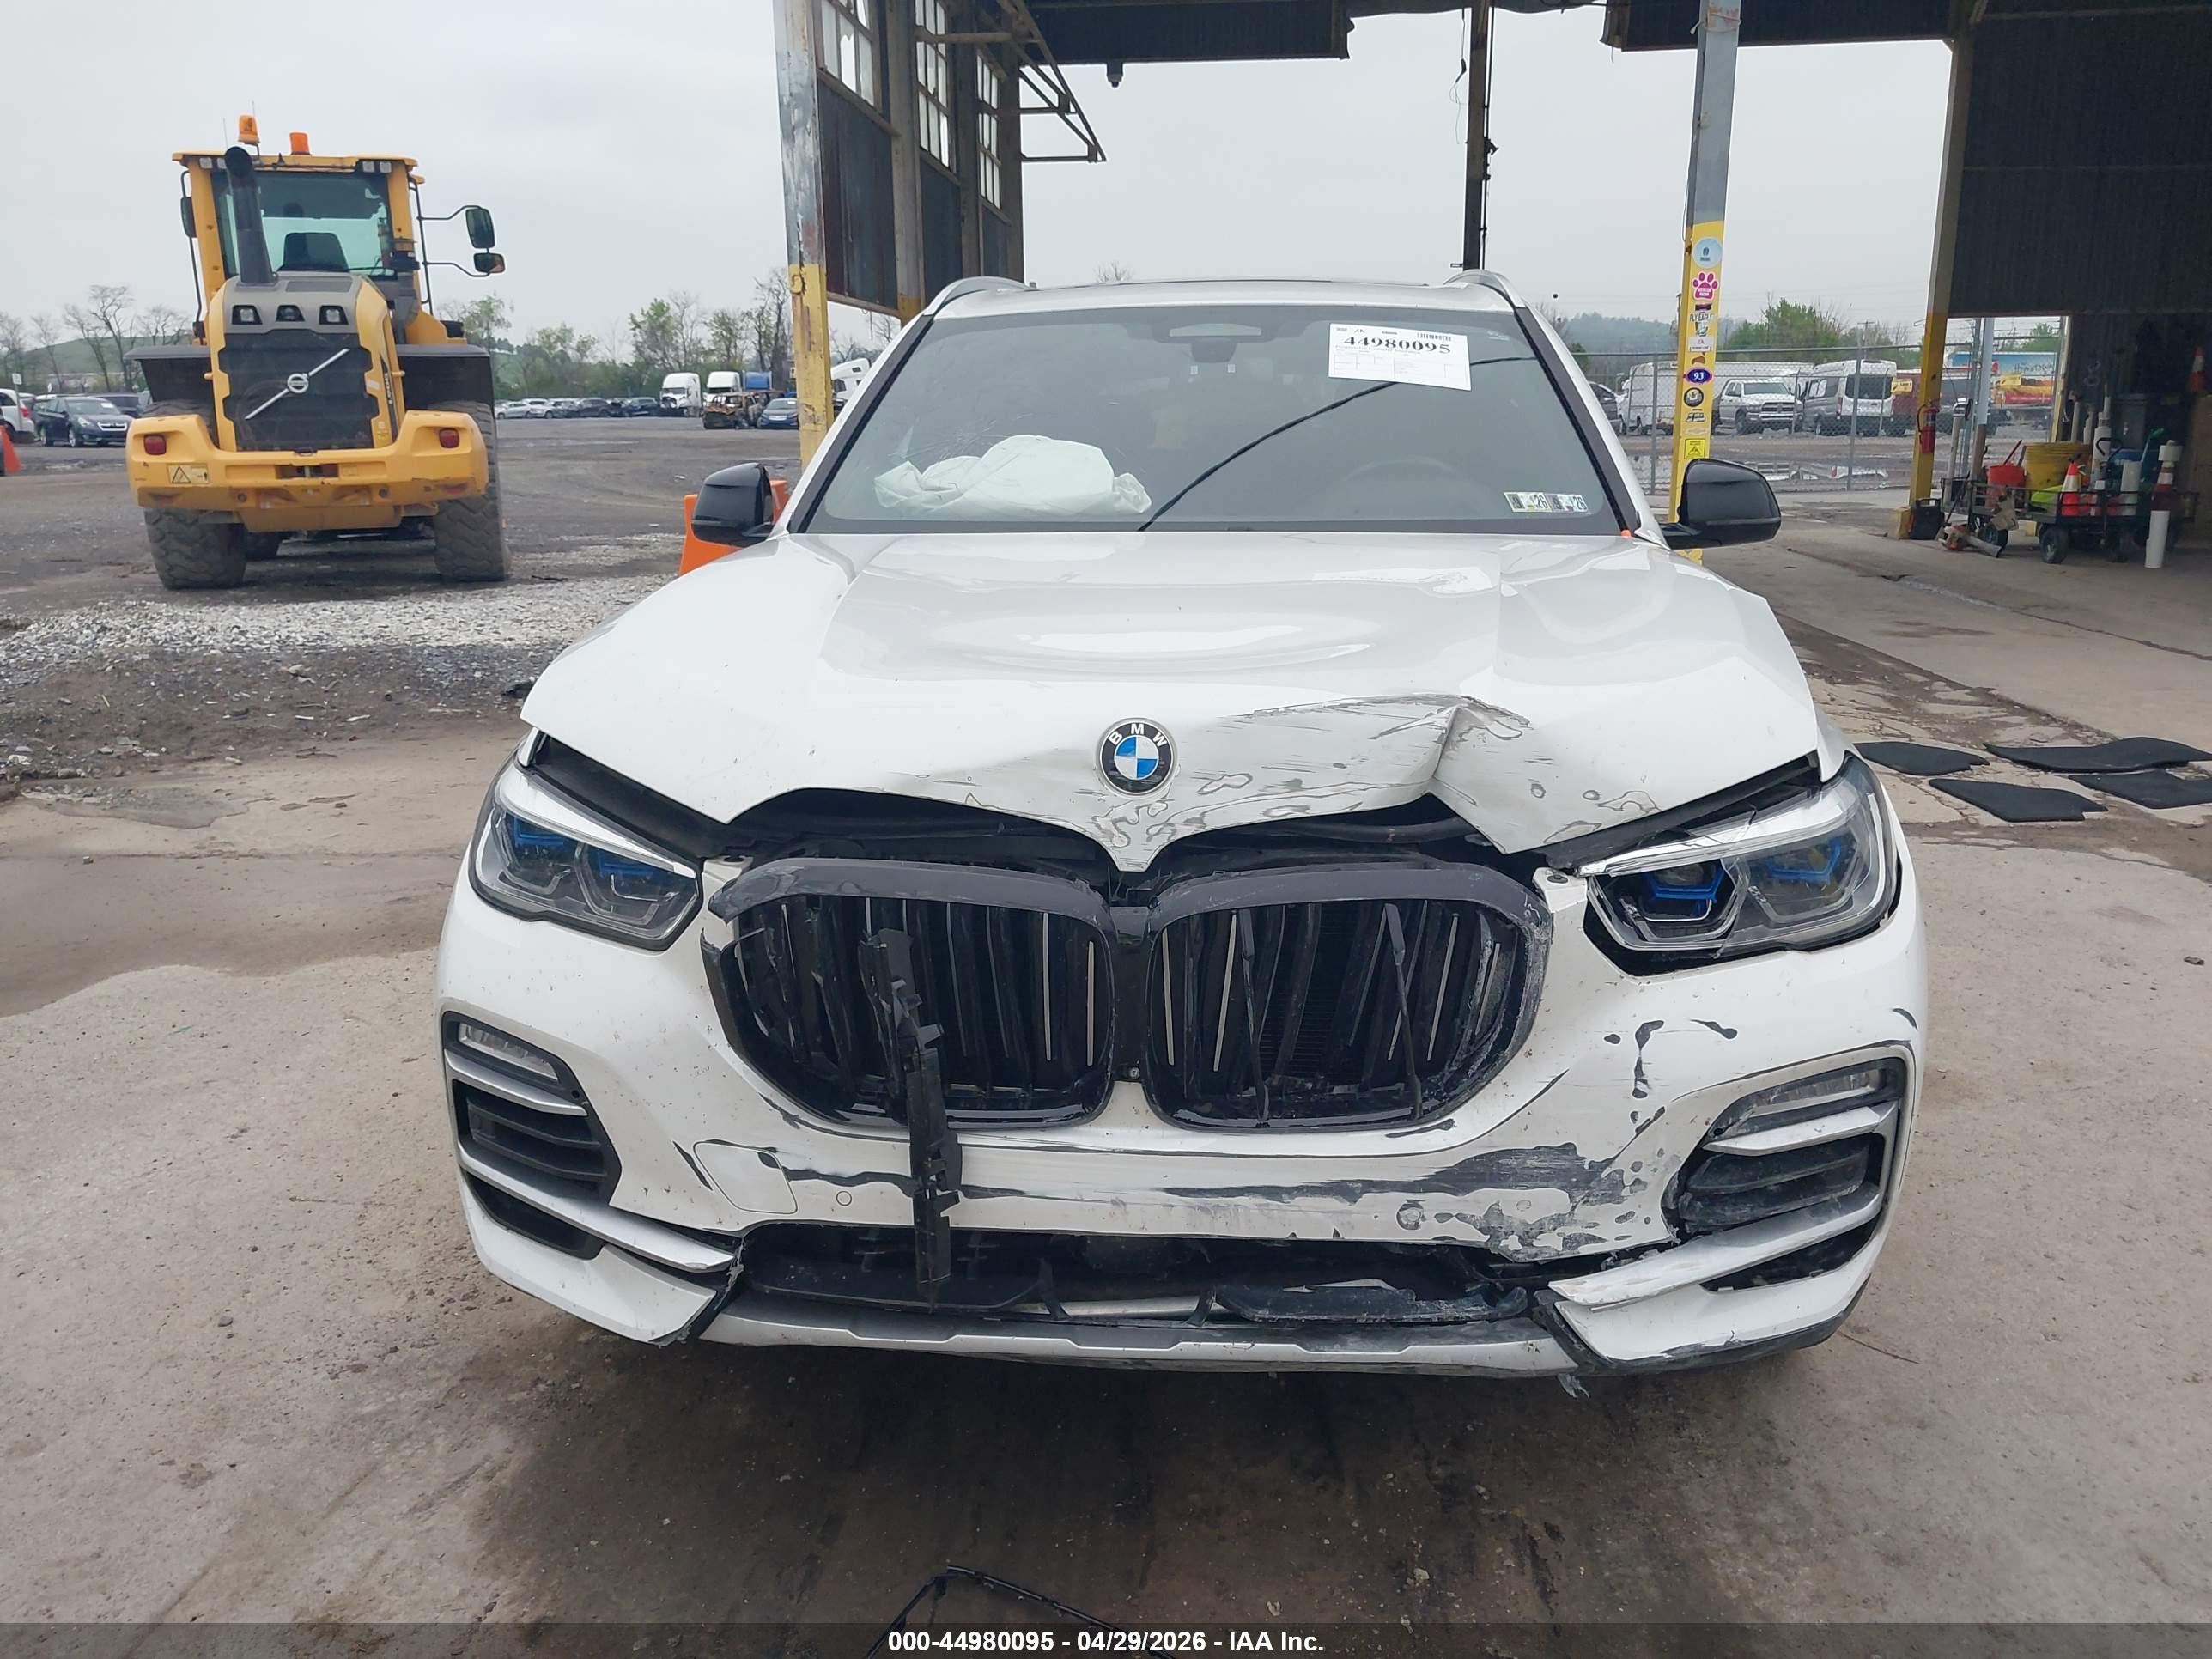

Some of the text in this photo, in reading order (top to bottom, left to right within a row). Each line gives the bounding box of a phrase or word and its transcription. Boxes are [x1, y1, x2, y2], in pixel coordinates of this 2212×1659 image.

[1344, 336, 1450, 354] 44980095
[1534, 495, 1548, 508] 26
[1573, 496, 1588, 509] 26
[1108, 724, 1168, 747] BMW
